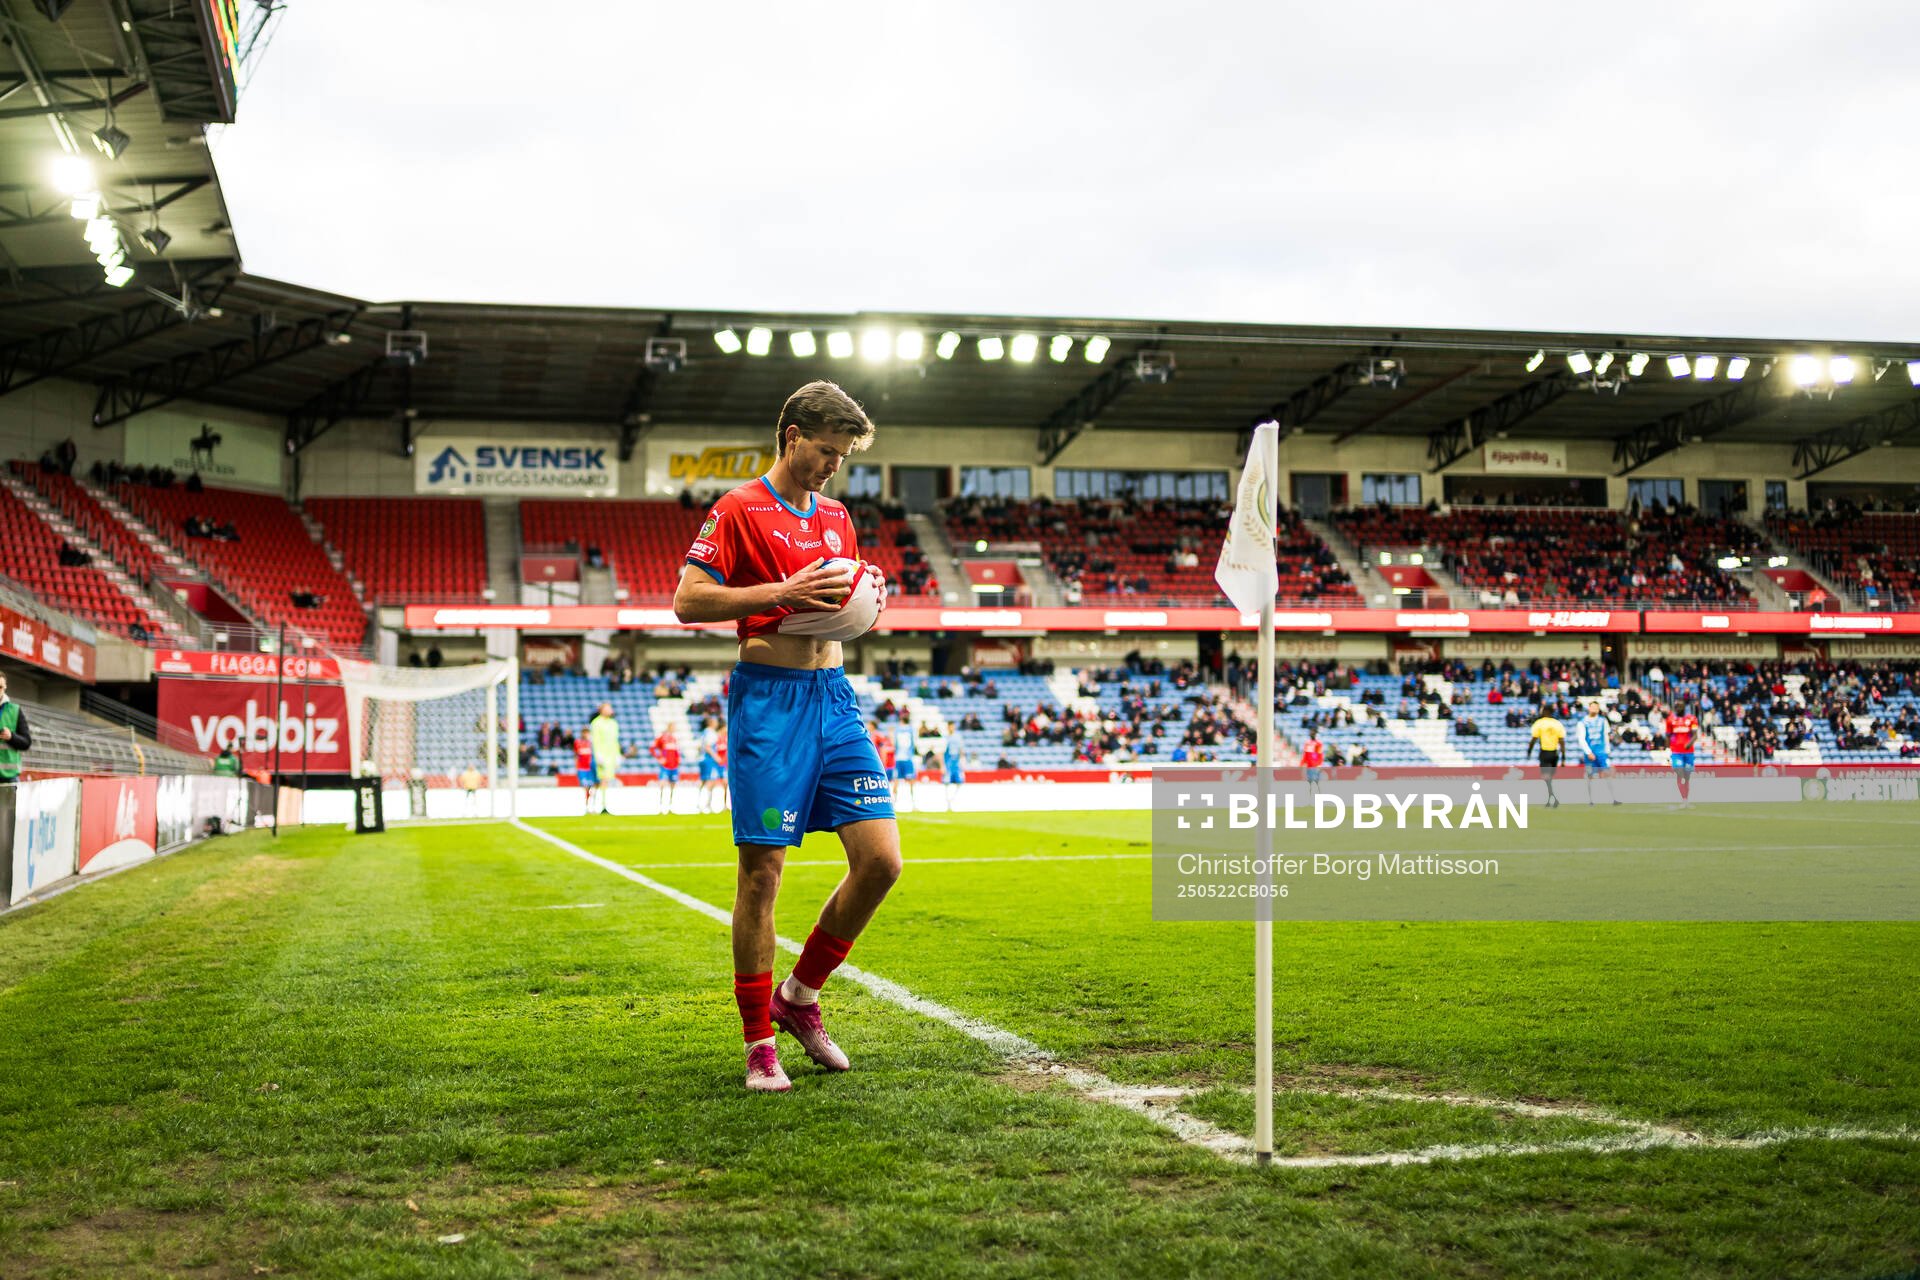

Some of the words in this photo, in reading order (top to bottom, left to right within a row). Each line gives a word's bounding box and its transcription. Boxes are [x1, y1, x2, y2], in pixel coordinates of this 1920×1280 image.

[476, 447, 606, 469] SVENSK
[475, 472, 609, 487] BYGGSTANDARD
[211, 655, 277, 675] FLAGGA
[190, 699, 339, 754] vobbiz
[1826, 778, 1919, 801] SUPERETTAN
